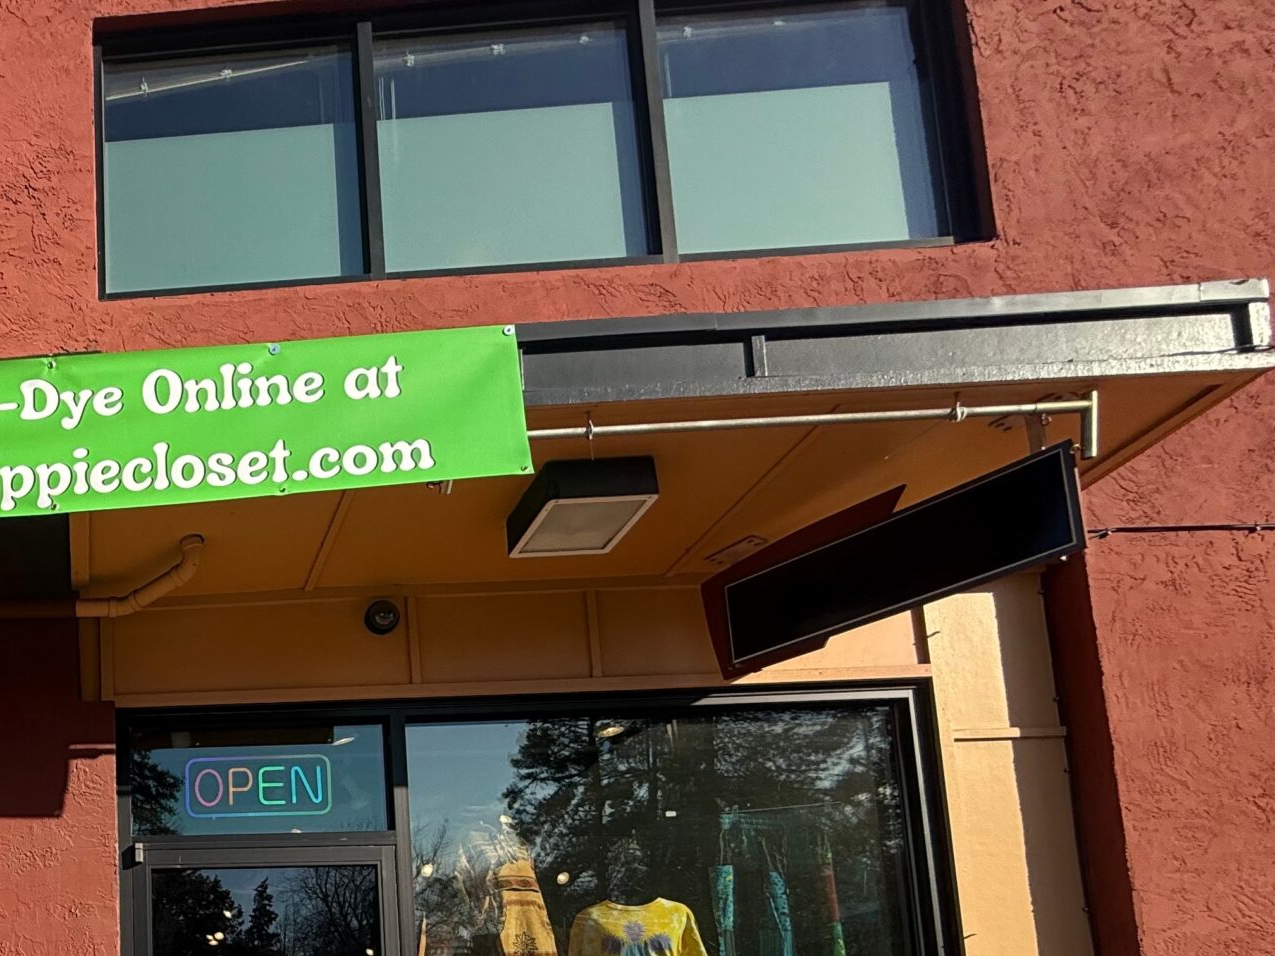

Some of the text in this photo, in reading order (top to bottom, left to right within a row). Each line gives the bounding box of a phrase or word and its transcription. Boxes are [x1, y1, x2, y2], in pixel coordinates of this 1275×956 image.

[142, 362, 325, 415] Online
[344, 355, 403, 400] at
[195, 765, 323, 806] OPEN
